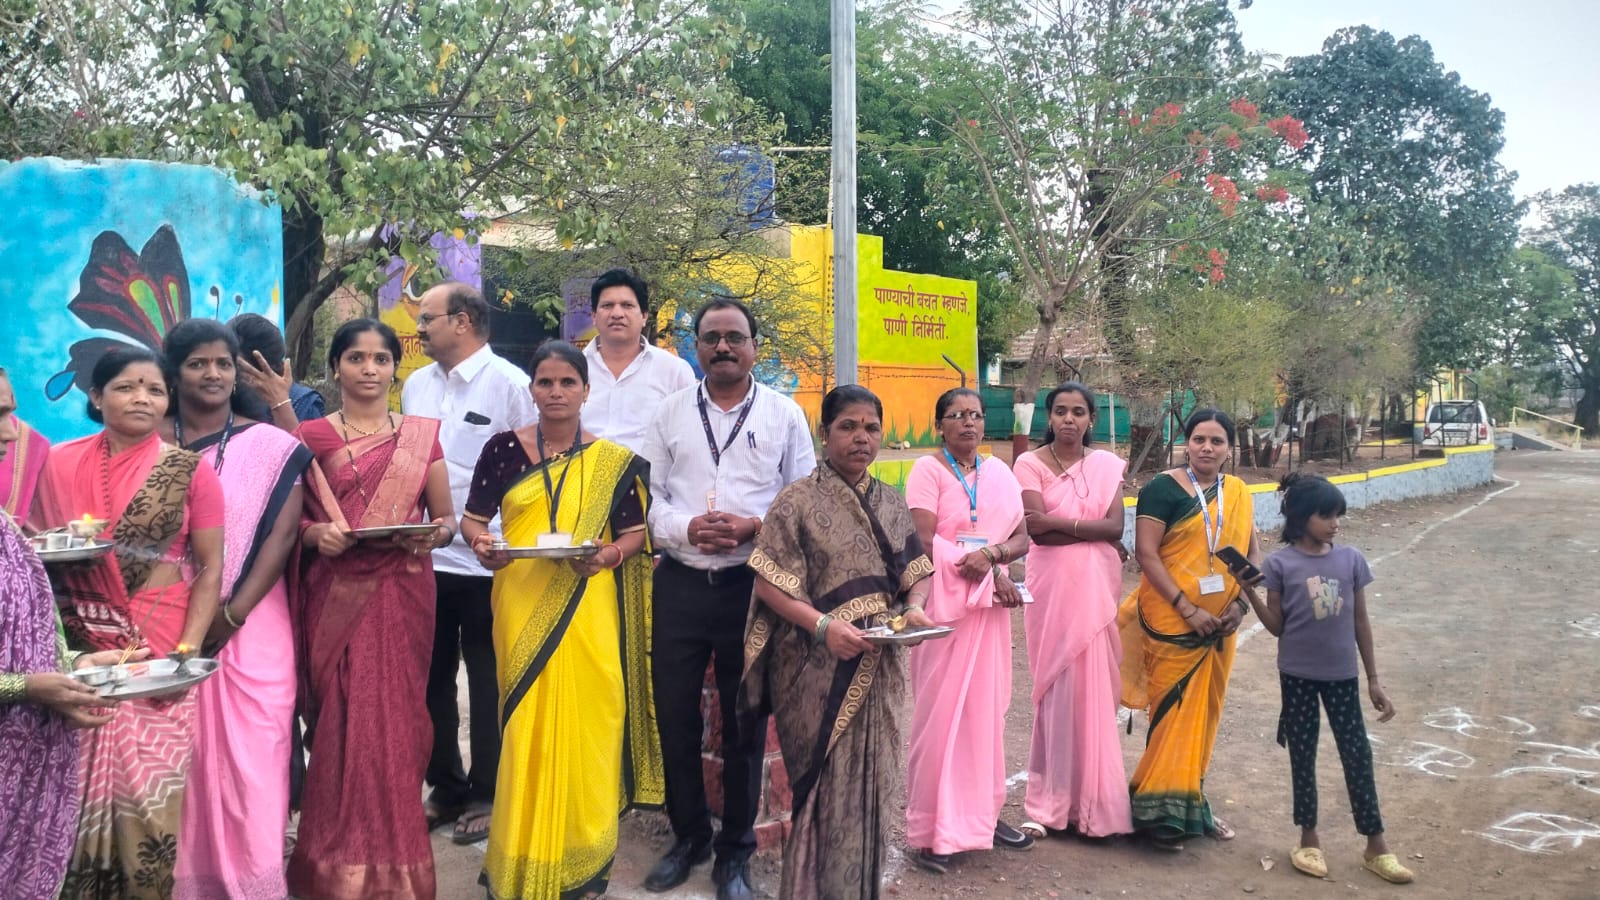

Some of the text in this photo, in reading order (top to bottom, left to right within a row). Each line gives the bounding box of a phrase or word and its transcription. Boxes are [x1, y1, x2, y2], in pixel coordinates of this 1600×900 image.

[874, 284, 915, 308] पाण्याची
[917, 292, 940, 310] बचत
[883, 313, 908, 337] पाणी
